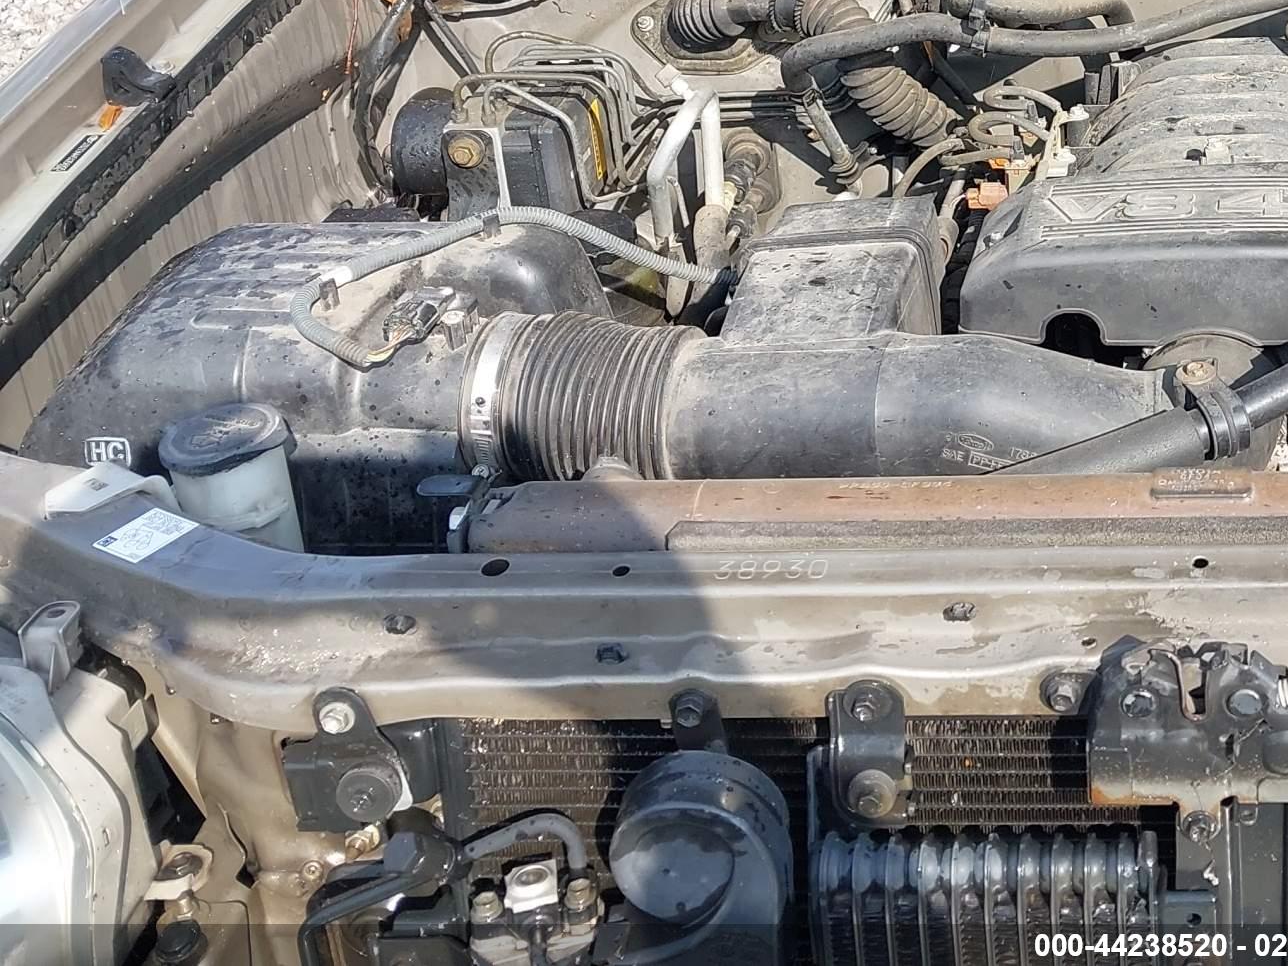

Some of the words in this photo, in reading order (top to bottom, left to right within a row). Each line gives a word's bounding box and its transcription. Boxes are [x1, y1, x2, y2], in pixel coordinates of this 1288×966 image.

[1043, 190, 1197, 223] V8
[90, 441, 125, 462] HC
[714, 560, 829, 580] 38930
